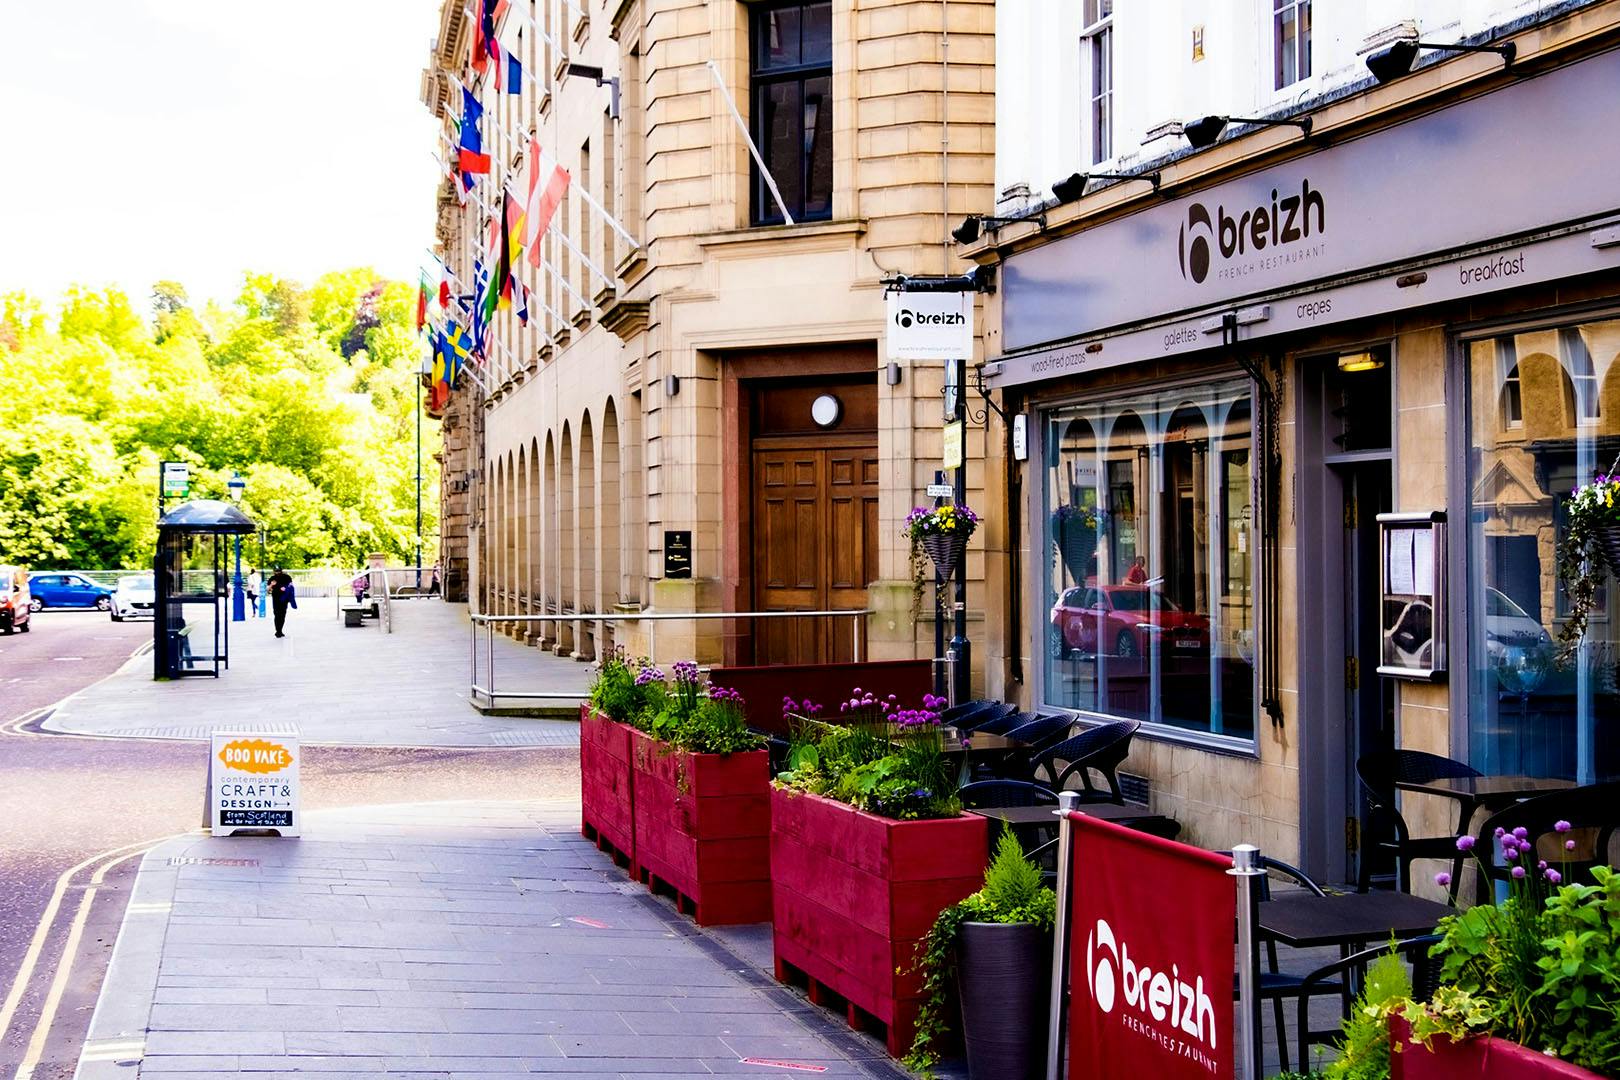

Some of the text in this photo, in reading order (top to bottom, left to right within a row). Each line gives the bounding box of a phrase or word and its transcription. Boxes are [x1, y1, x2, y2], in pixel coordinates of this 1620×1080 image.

[1218, 178, 1325, 259] breizh
[1218, 244, 1326, 280] FRENCH RESTAURANT
[1459, 252, 1525, 285] breakfast
[916, 312, 965, 325] breizh
[1296, 299, 1332, 320] crepes
[1164, 328, 1198, 351] galettes
[1031, 352, 1087, 373] wood-fired pizzas
[226, 748, 284, 764] BOO VAKE
[221, 800, 272, 808] DESIGN
[226, 811, 287, 820] from Scotland
[1122, 941, 1217, 1050] breizh
[1122, 1013, 1157, 1041] FRENCH
